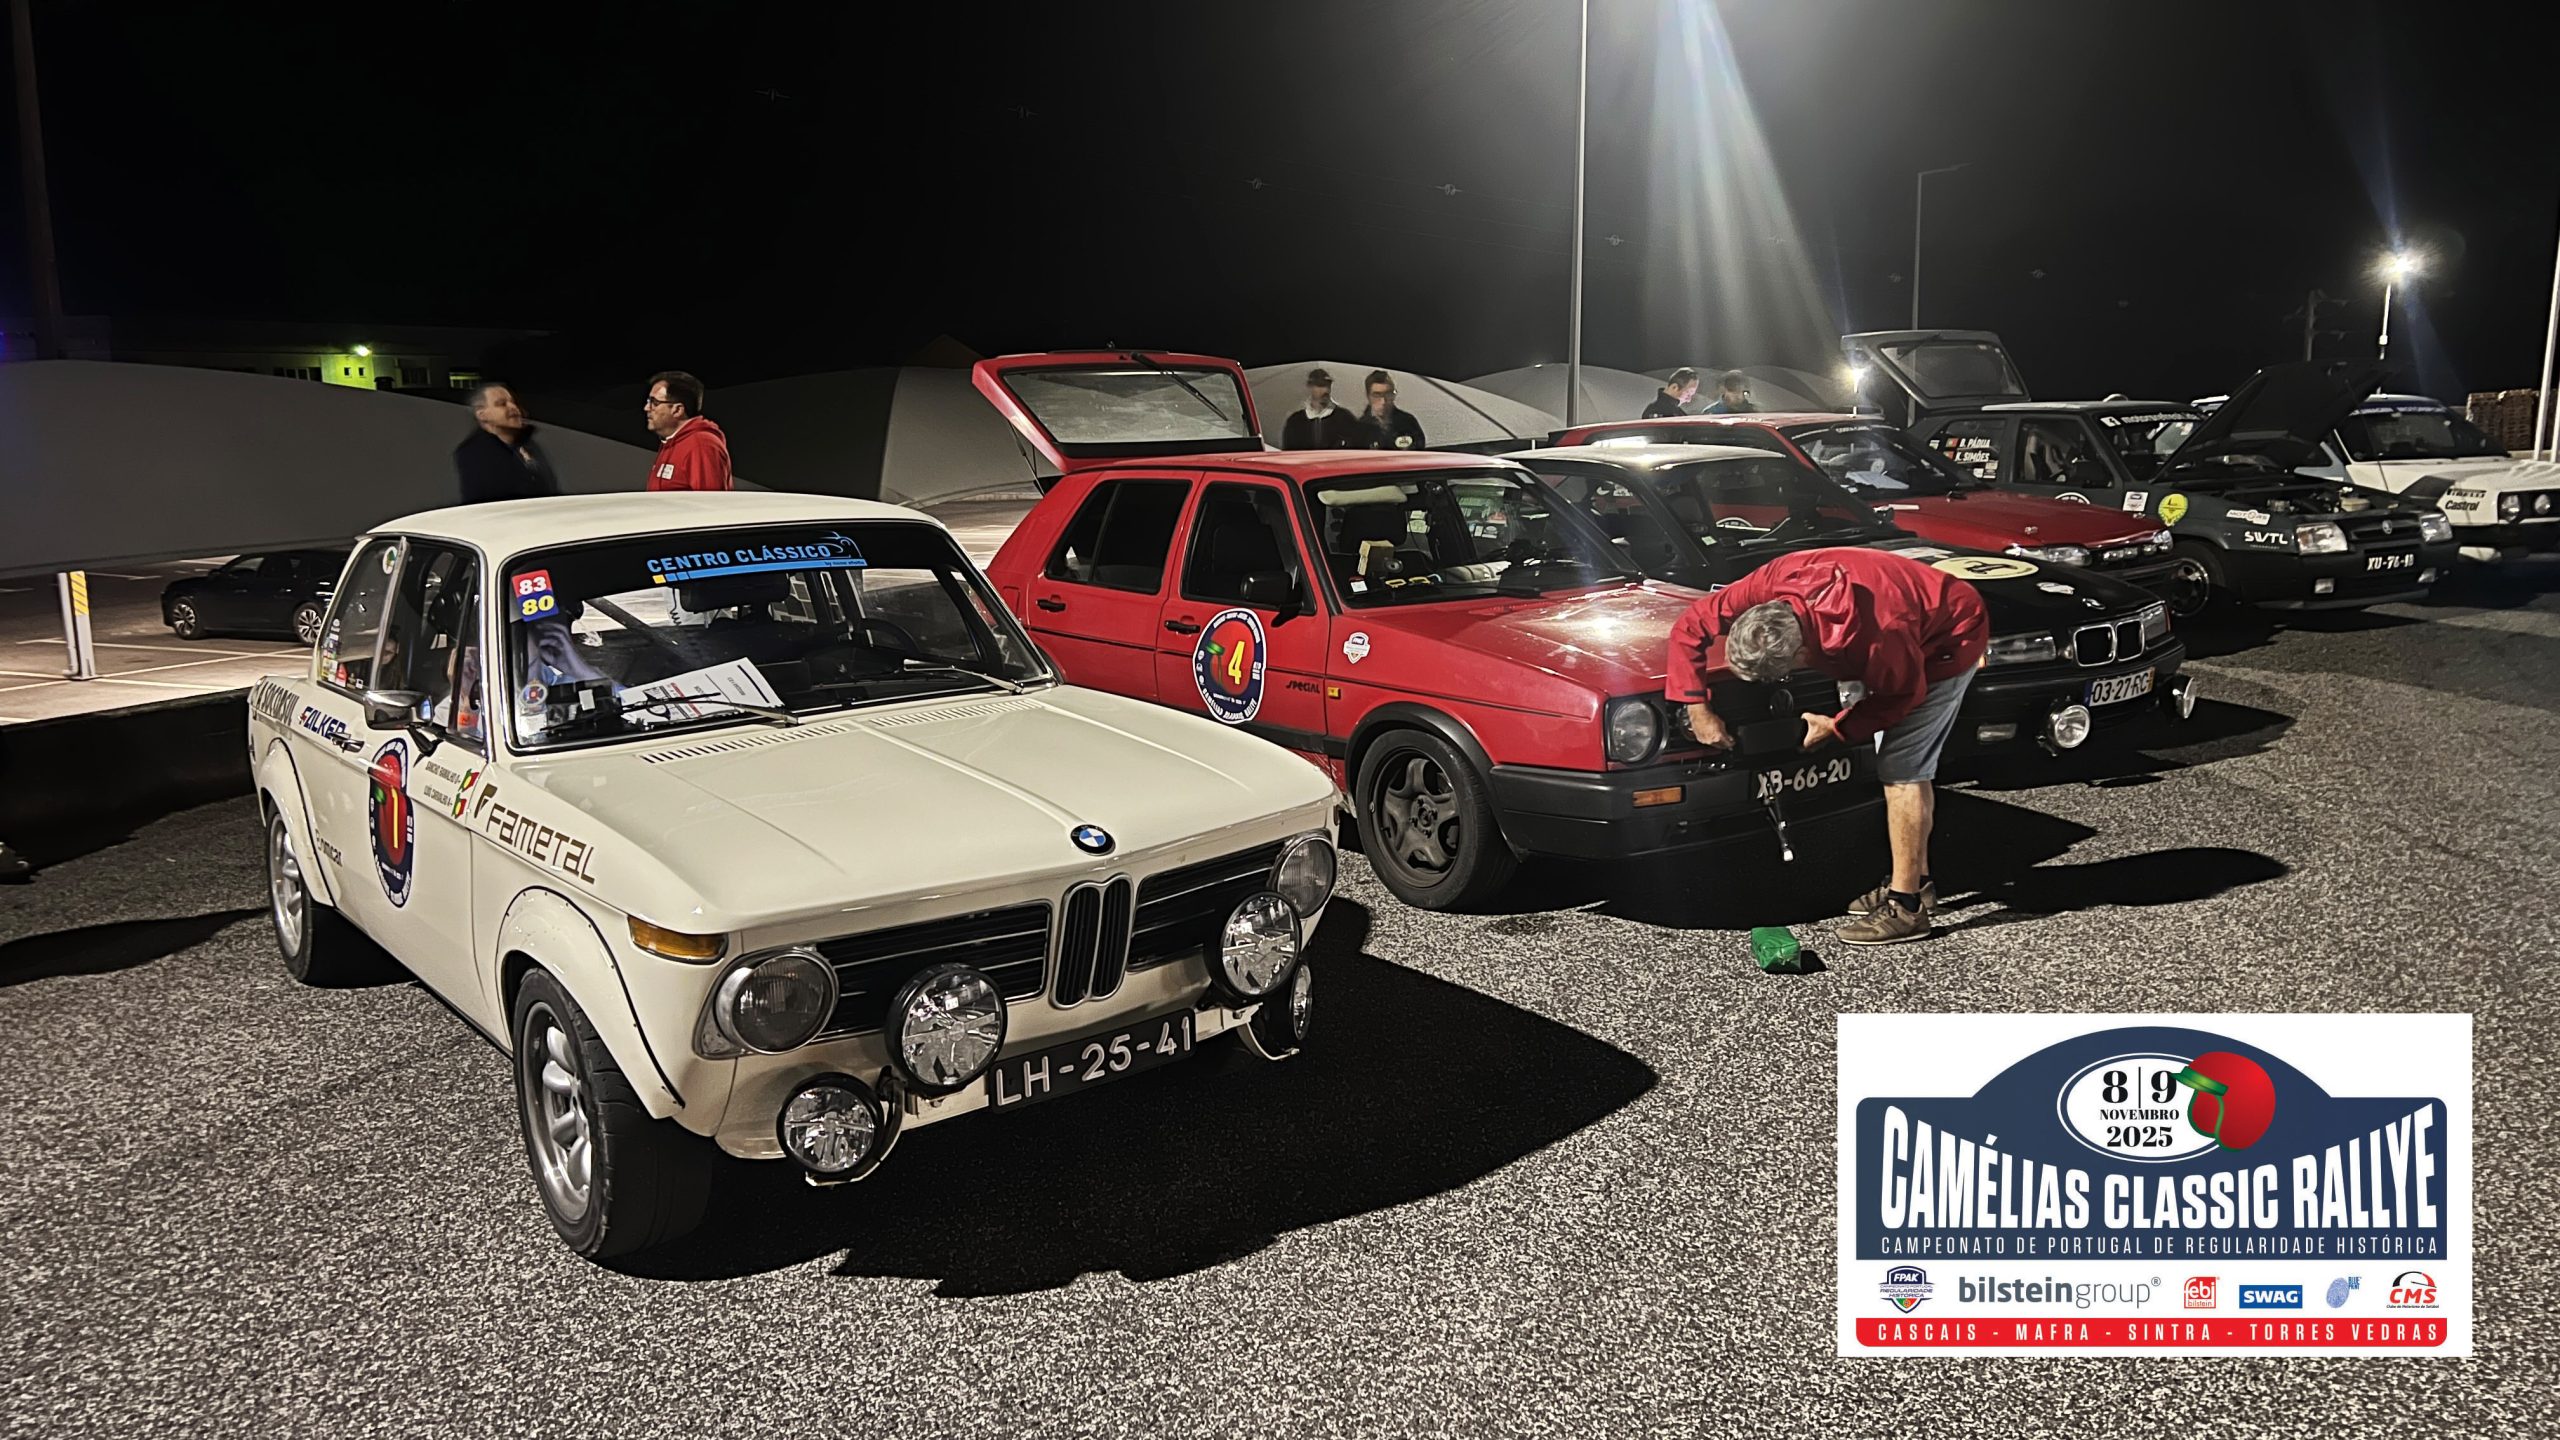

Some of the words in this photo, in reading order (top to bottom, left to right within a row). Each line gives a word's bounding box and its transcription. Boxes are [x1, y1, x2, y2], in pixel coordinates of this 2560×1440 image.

[2445, 500, 2480, 511] Castrol
[647, 551, 730, 573] CENTRO
[735, 545, 831, 563] CLÁSSICO
[519, 576, 547, 595] 83
[522, 595, 554, 615] 80
[1228, 641, 1246, 685] 4
[391, 786, 399, 849] 1
[996, 1016, 1190, 1106] LH-25-41
